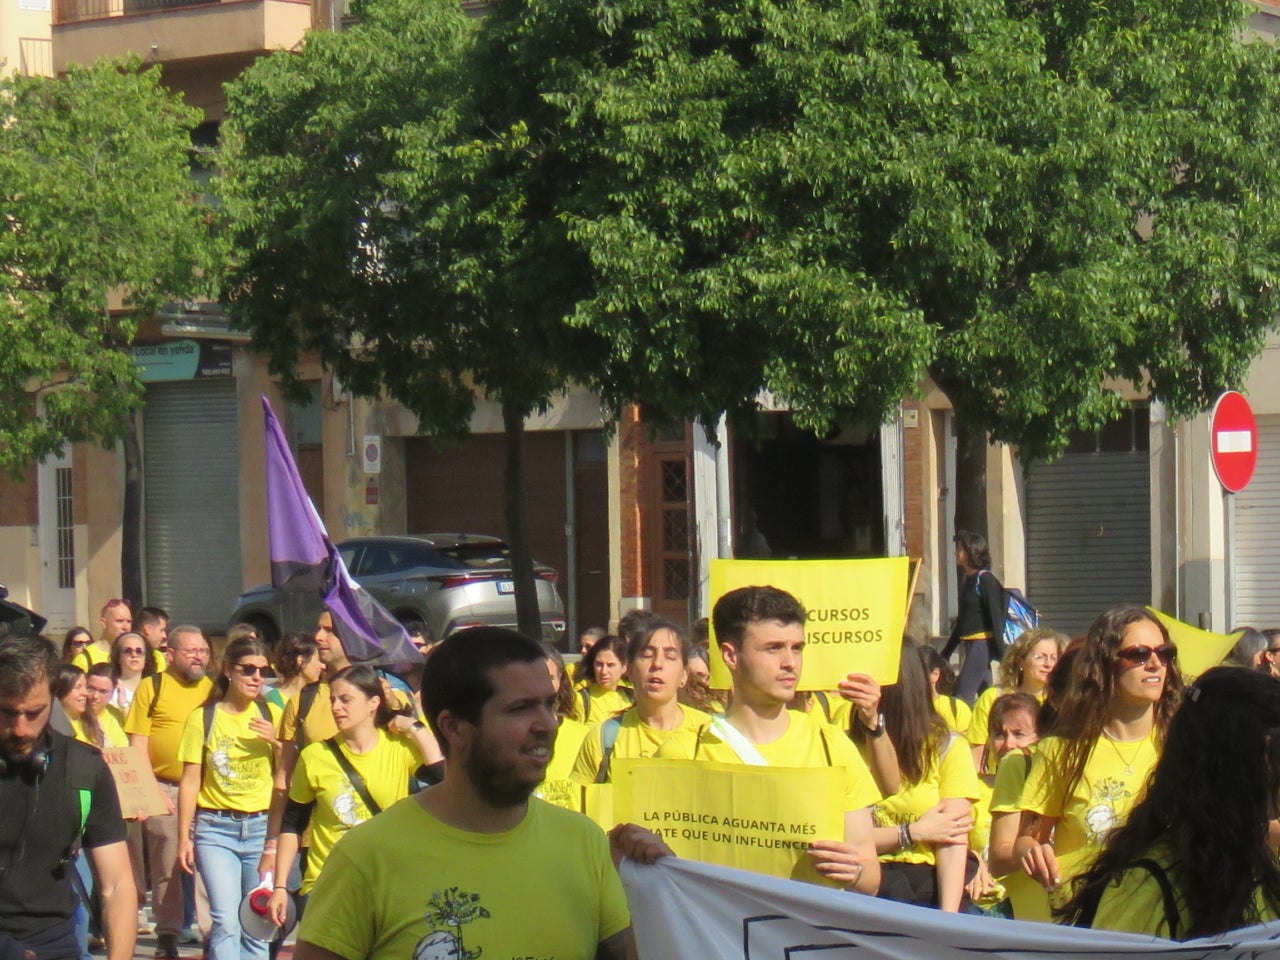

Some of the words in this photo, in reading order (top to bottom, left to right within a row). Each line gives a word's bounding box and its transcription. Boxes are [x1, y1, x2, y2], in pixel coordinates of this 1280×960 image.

[806, 608, 870, 622] CURSOS
[807, 629, 883, 645] ISCURSOS
[643, 811, 661, 822] LA
[663, 809, 719, 826] PÚBLICA
[722, 816, 786, 833] AGUANTA
[789, 821, 817, 836] MÉS
[650, 828, 678, 838] ATE
[681, 828, 709, 843] QUE
[711, 831, 732, 844] UN
